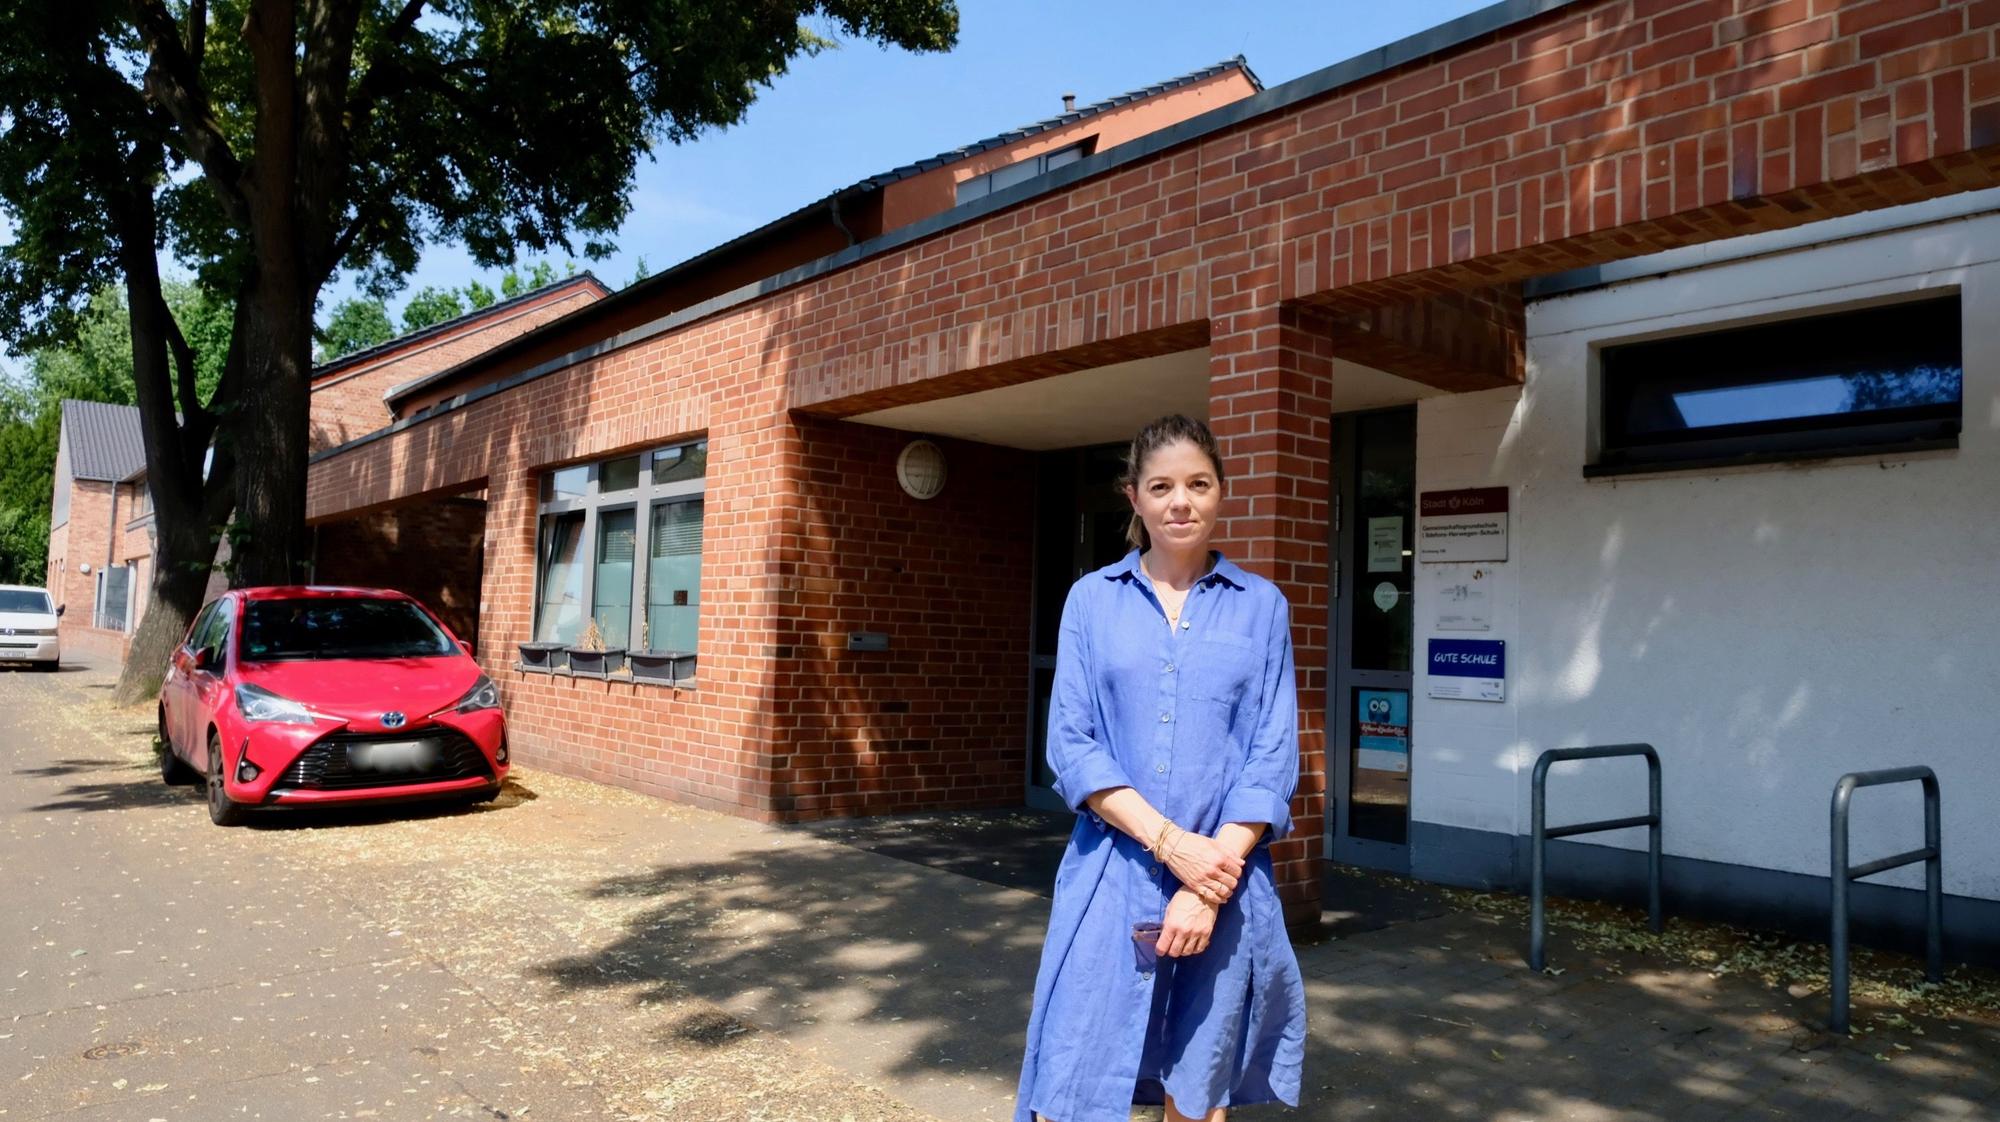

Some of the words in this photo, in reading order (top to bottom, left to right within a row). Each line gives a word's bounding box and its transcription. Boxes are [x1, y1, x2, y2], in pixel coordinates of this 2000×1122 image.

[1423, 498, 1446, 509] Stadt
[1462, 496, 1484, 506] Köln
[1434, 653, 1459, 663] GUTE
[1460, 654, 1497, 664] SCHULE
